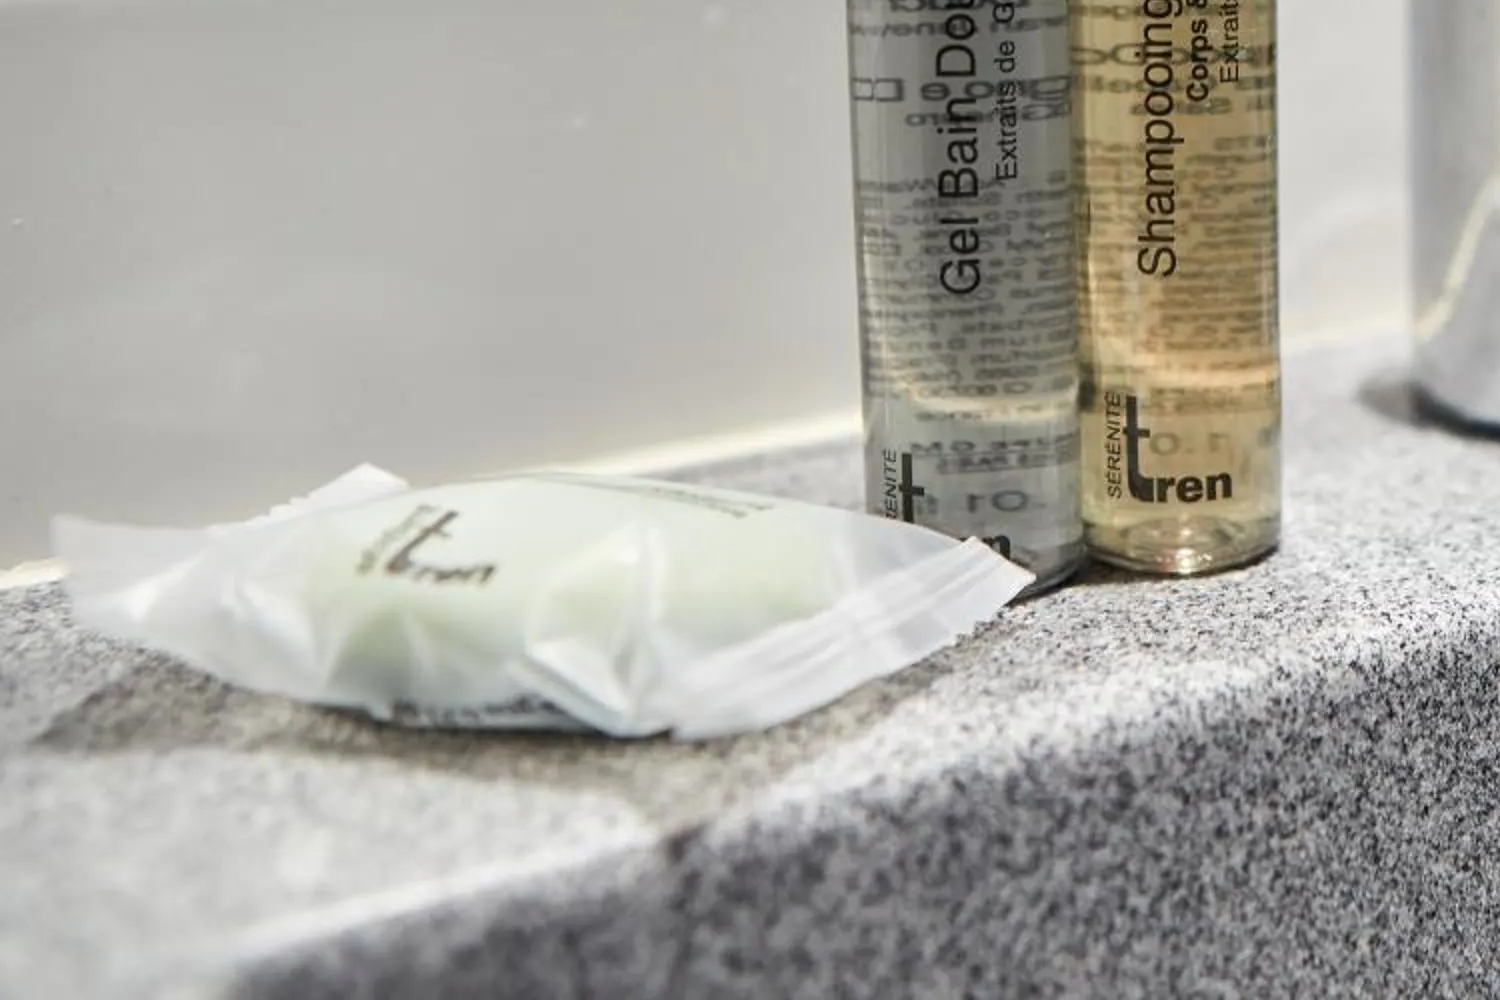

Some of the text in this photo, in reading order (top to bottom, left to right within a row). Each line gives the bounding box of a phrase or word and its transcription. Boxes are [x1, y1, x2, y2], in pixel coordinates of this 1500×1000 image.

[993, 40, 1017, 74] de
[1187, 18, 1211, 103] Corps
[936, 97, 980, 199] Bain
[994, 80, 1018, 181] Extraits
[938, 217, 981, 295] Gel
[881, 448, 899, 521] RÉNITÉ
[1106, 390, 1124, 500] SÉRÉNITÉ
